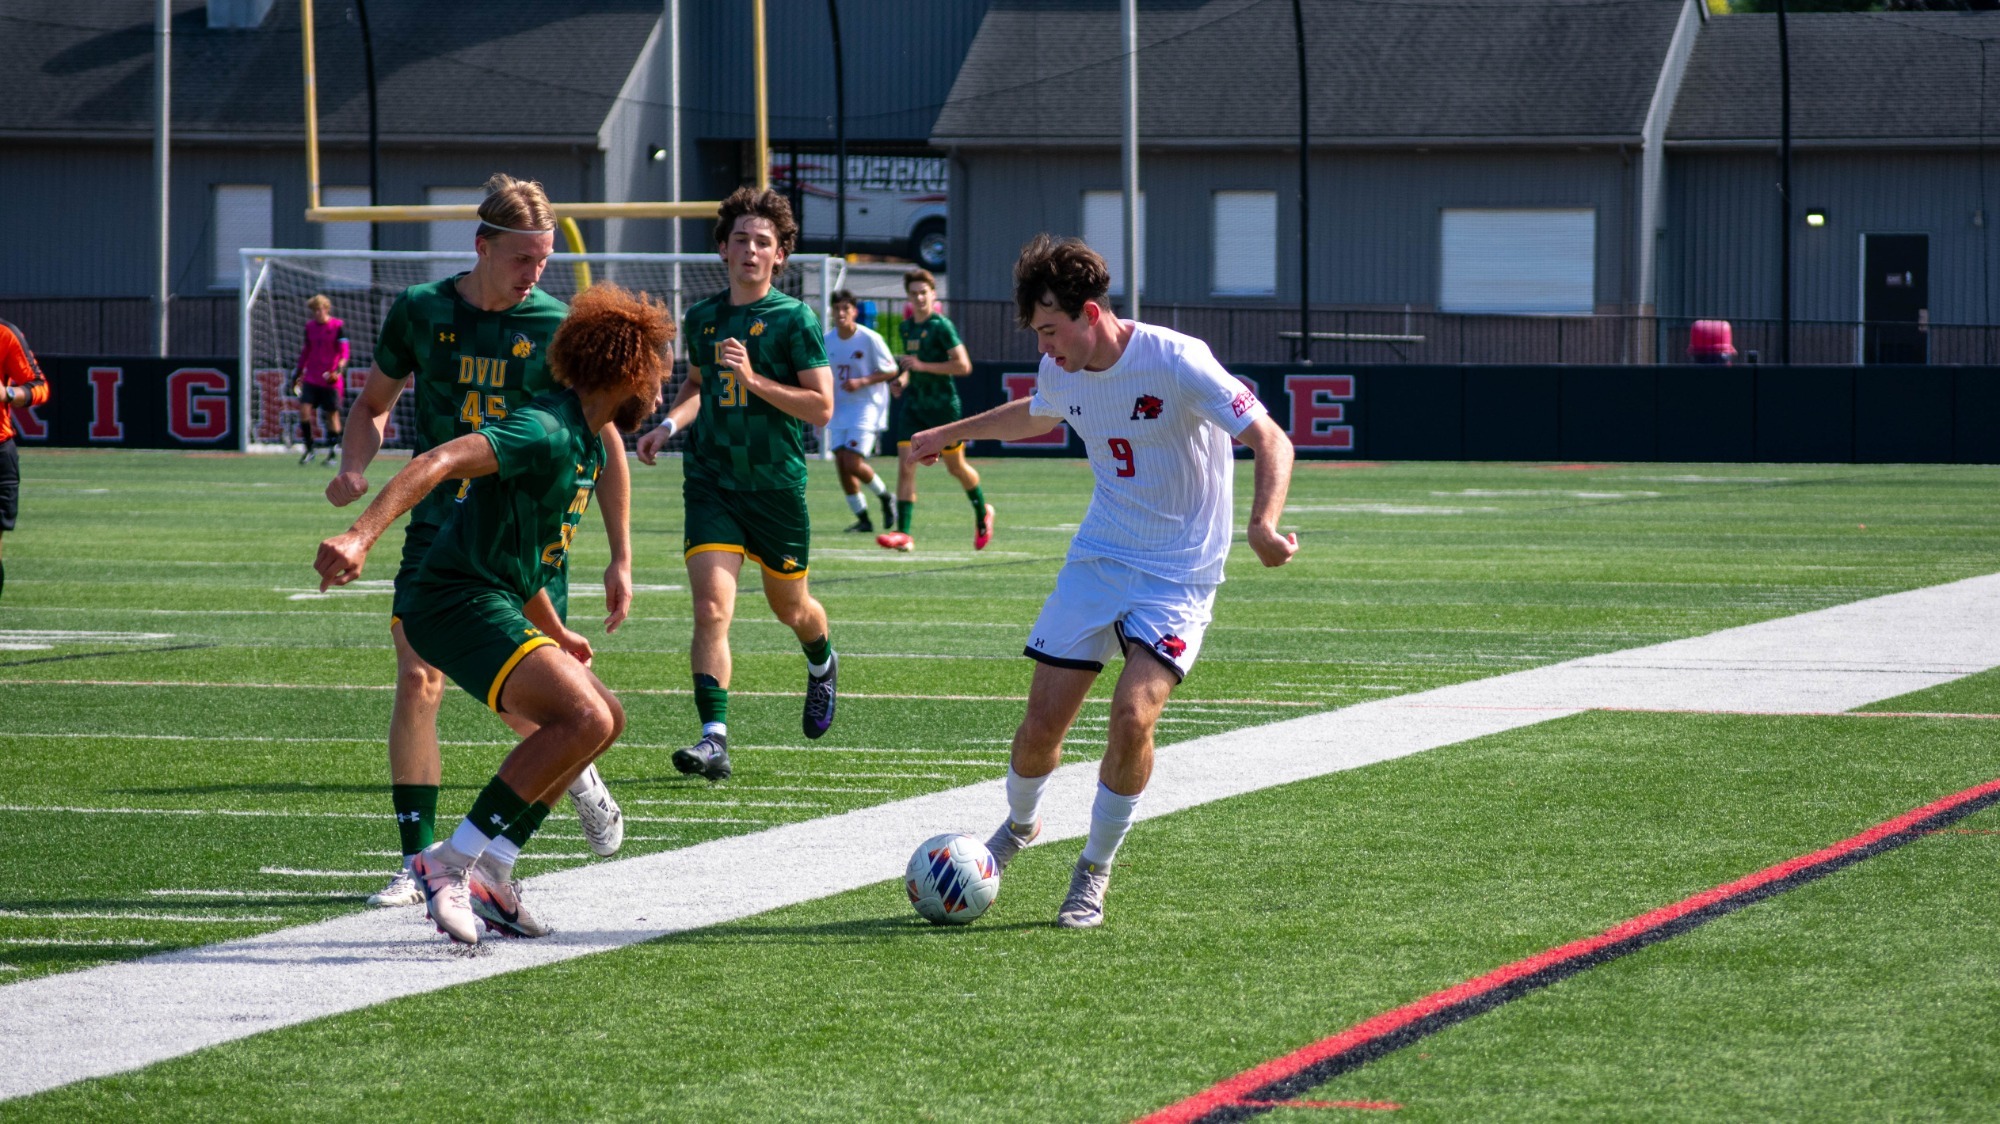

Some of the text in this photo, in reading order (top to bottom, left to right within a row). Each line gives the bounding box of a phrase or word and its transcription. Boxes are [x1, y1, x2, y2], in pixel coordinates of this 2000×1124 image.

[458, 355, 507, 387] DVU
[718, 371, 748, 407] 31
[460, 391, 508, 432] 45
[1107, 438, 1136, 477] 9
